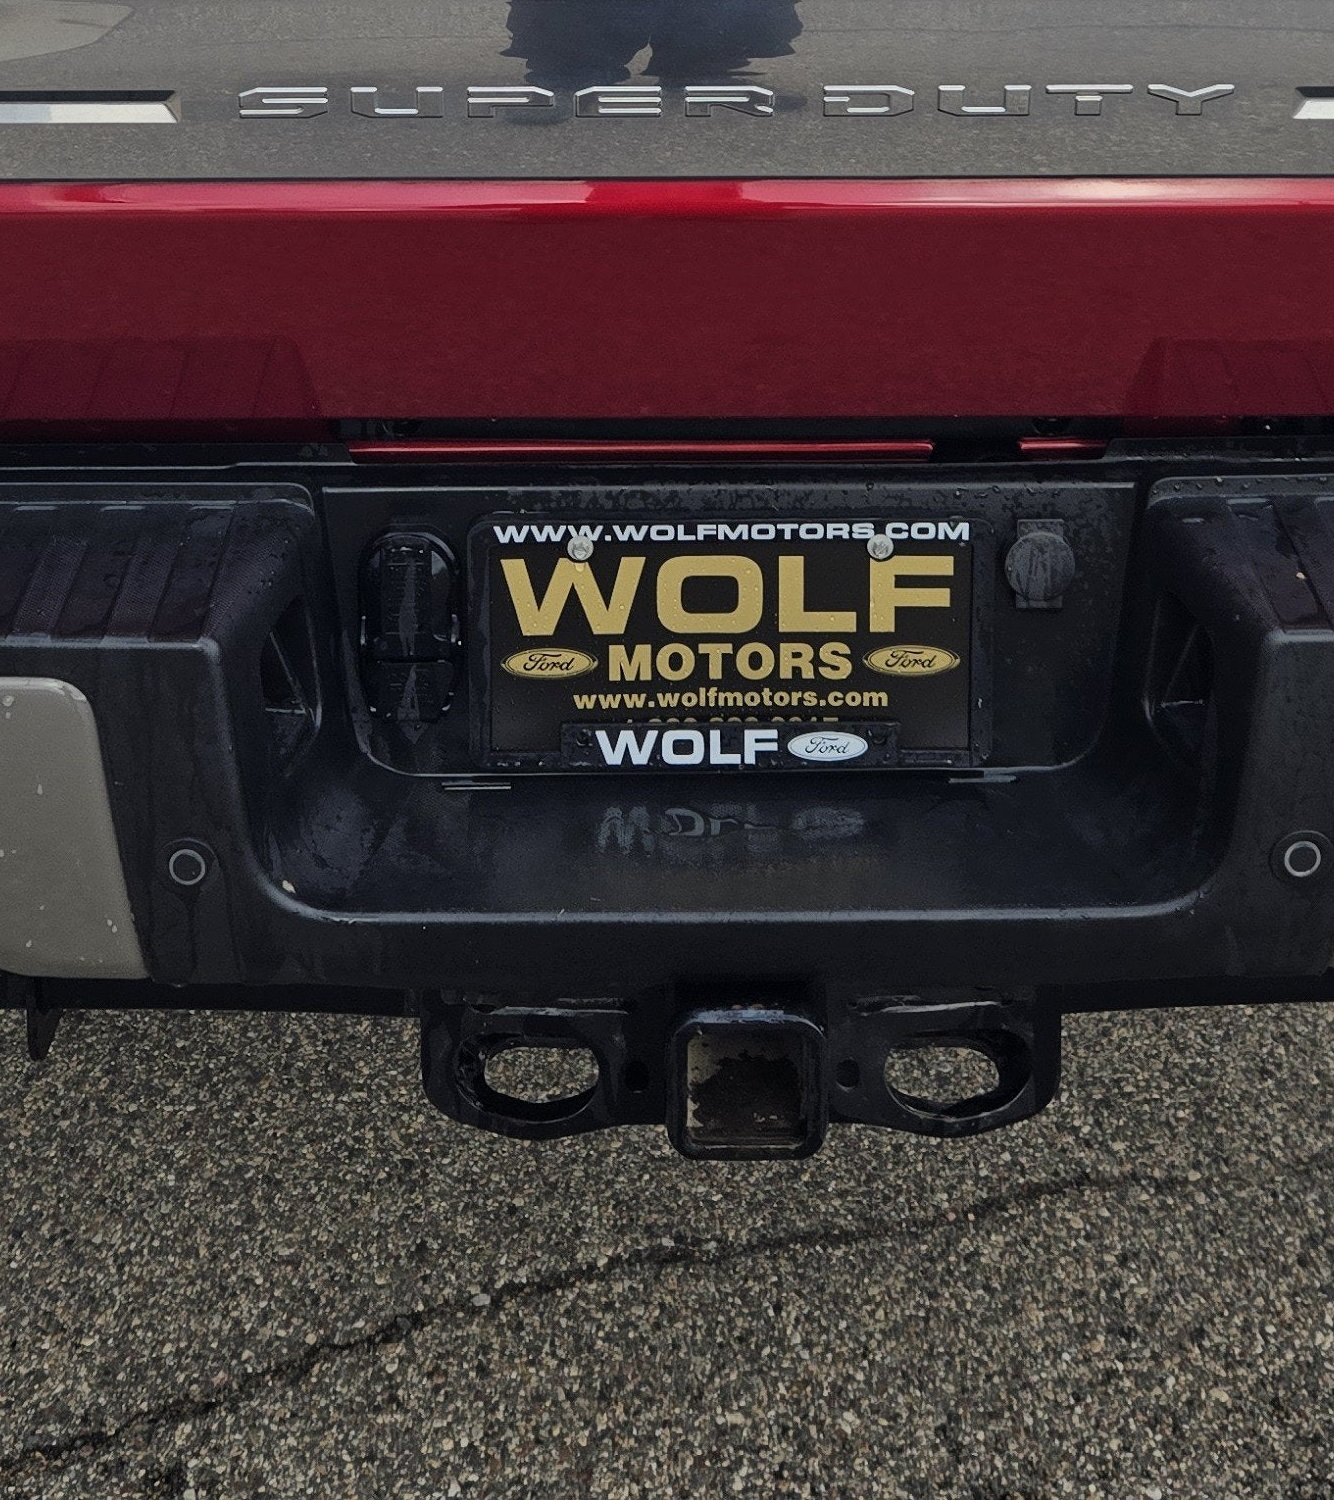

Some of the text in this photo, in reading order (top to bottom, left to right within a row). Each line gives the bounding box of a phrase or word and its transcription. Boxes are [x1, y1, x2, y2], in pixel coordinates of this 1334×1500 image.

[238, 84, 1236, 119] SUPER DUTY
[493, 521, 971, 545] WWW.WOLFMOTORS.COM
[500, 553, 955, 637] WOLF
[521, 653, 575, 674] Ford
[608, 642, 853, 682] MOTORS
[884, 650, 937, 671] Ford
[572, 687, 889, 710] www.wolfmotors.com
[595, 729, 779, 766] WOLF
[804, 735, 851, 758] Ford
